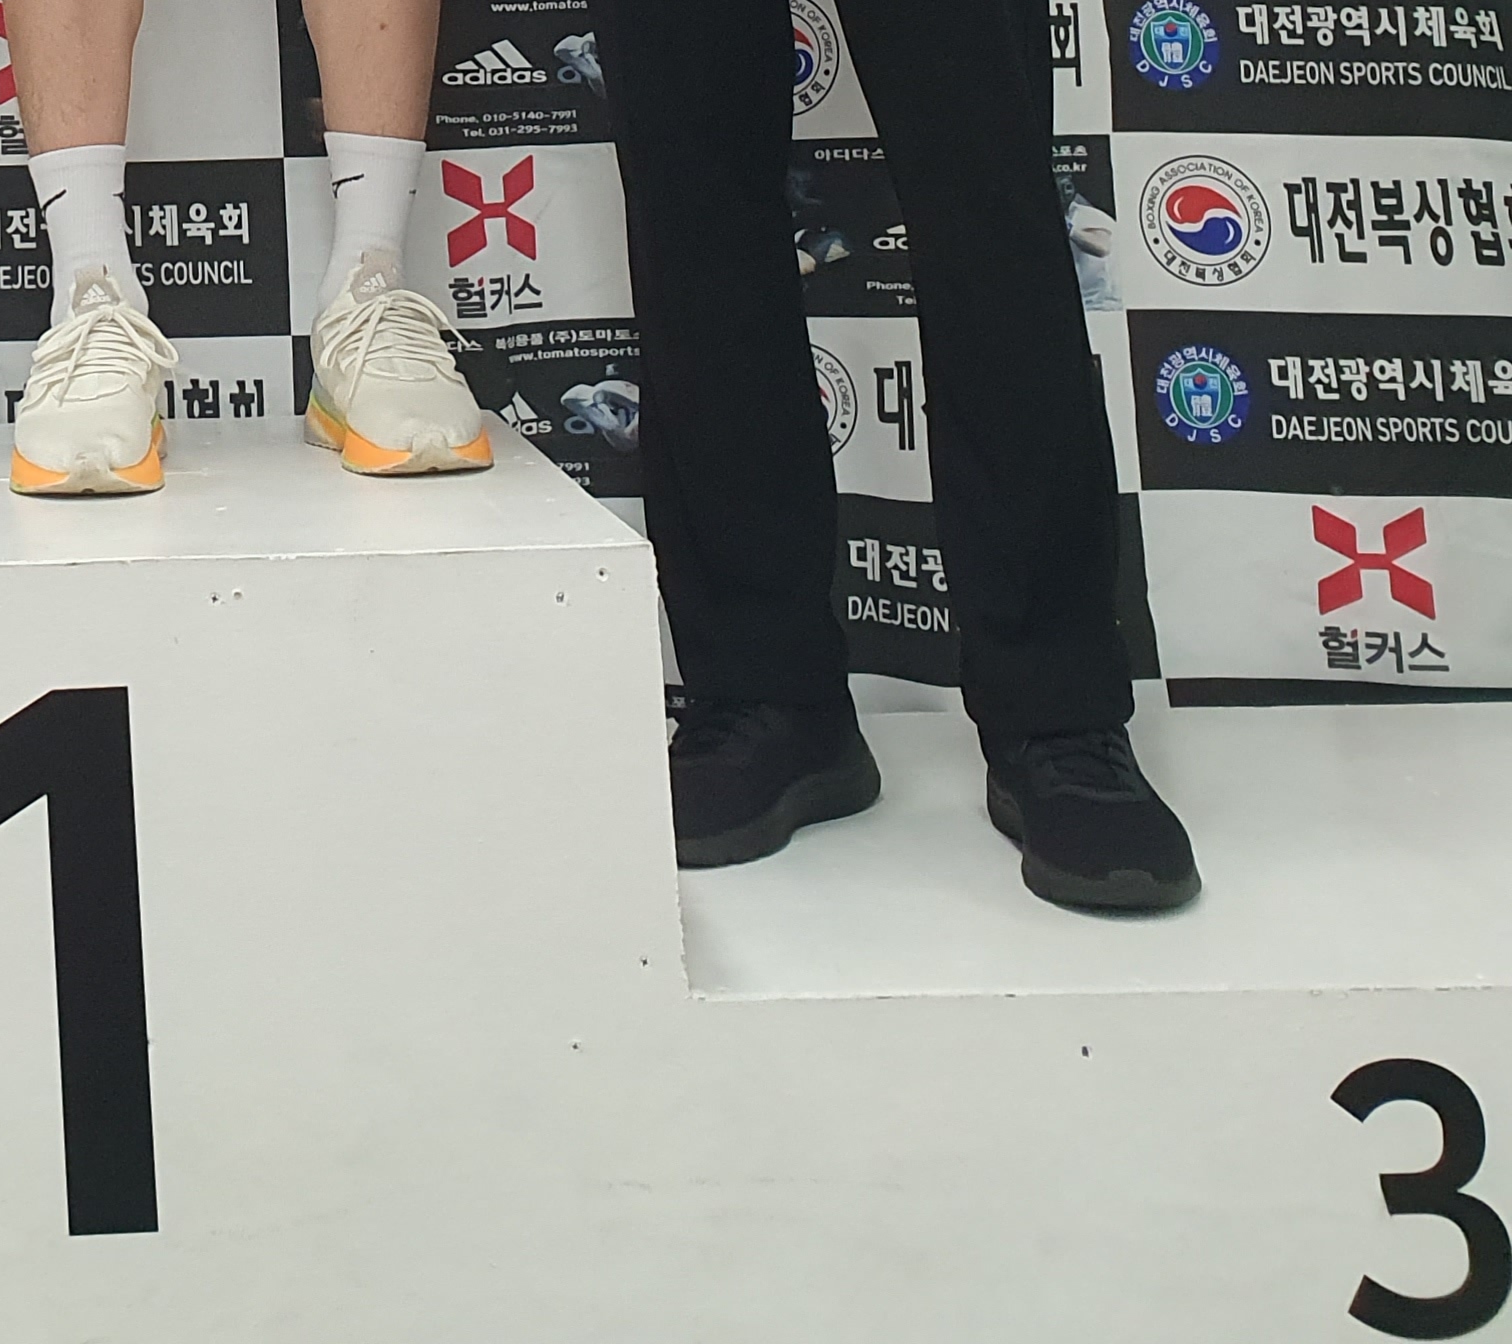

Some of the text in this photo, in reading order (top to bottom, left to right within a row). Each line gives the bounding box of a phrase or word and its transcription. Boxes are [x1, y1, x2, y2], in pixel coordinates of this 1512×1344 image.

[1236, 4, 1504, 50] 대전광역시체육회
[442, 70, 547, 85] adidas
[1240, 61, 1512, 90] DAEJEON SPORTS COUNCIL
[483, 110, 578, 123] 010-5140-7991
[489, 124, 578, 137] 031-295-7993
[814, 148, 886, 160] 아디다스
[1284, 177, 1512, 267] 대전복싱협
[161, 261, 252, 286] COUNCIL
[448, 272, 543, 319] 헐커스
[1272, 416, 1460, 443] DAEJEON SPORTS
[848, 596, 950, 632] DAEJEON
[1319, 626, 1450, 674] 헐커스
[1329, 1058, 1512, 1342] 3
